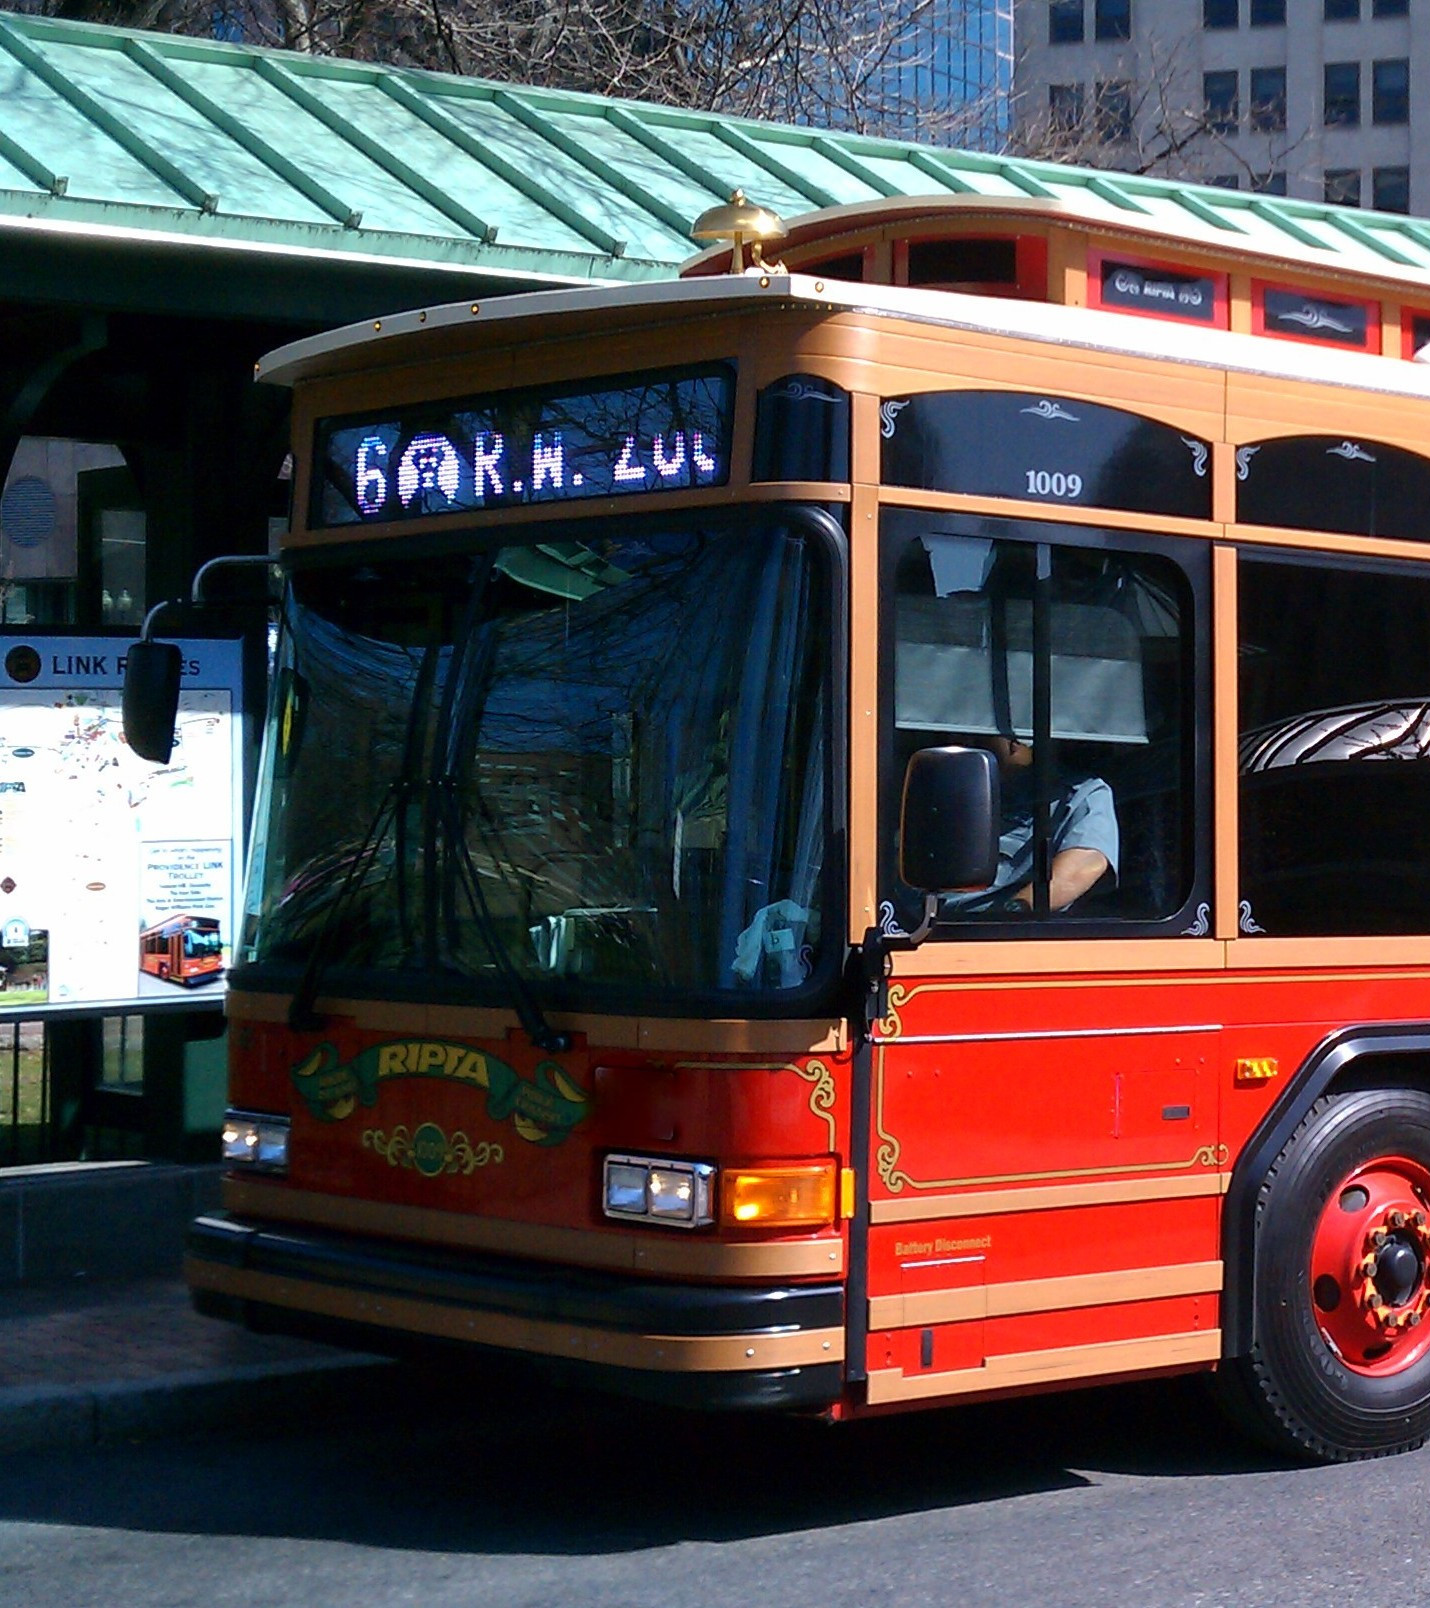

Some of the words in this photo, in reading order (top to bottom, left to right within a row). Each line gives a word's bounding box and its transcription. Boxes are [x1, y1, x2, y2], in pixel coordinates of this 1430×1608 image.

[356, 436, 387, 514] 6
[1025, 470, 1083, 497] 1009
[52, 655, 108, 675] LINK
[117, 656, 201, 676] RES
[378, 1042, 490, 1088] RIPTA
[895, 1242, 934, 1256] Battery
[935, 1235, 991, 1252] Disconnect
